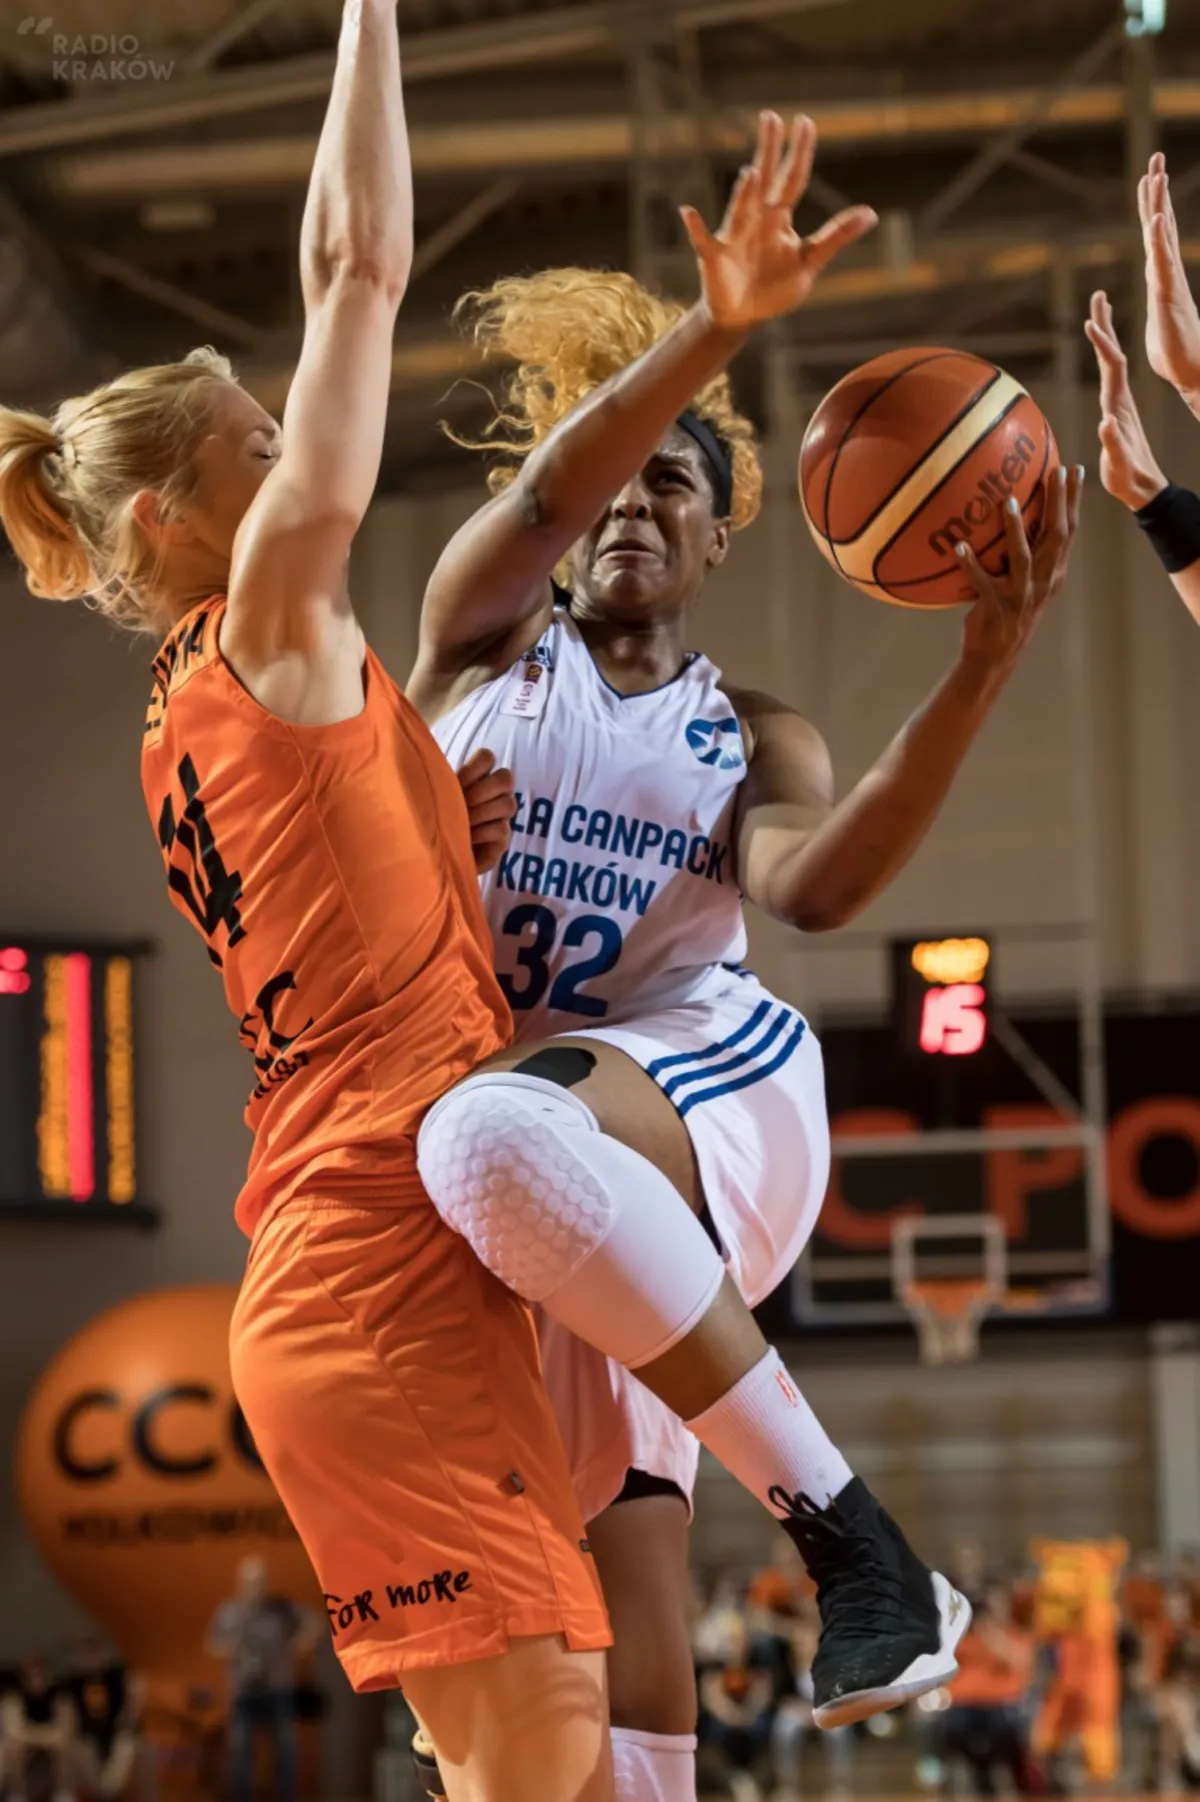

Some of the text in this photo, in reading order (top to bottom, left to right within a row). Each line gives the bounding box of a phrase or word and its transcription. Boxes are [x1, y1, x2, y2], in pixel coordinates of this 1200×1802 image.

[927, 434, 1036, 557] molten
[497, 851, 656, 916] KRAKÓW
[561, 805, 727, 884] CANPACK
[496, 904, 622, 1017] 32
